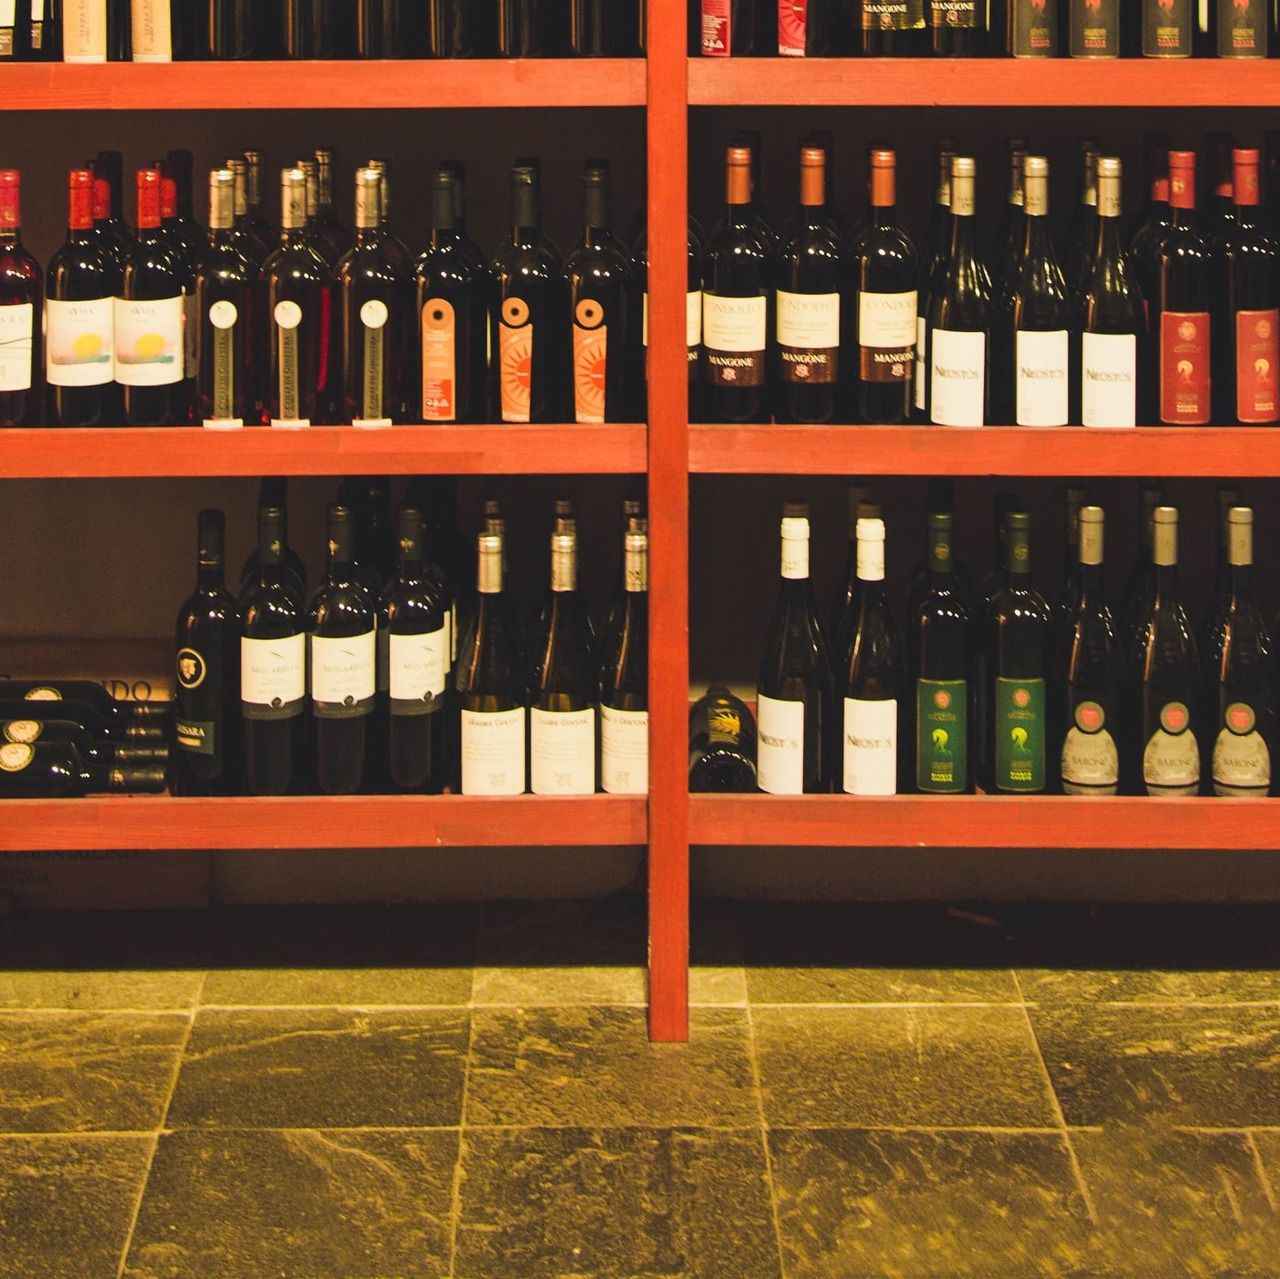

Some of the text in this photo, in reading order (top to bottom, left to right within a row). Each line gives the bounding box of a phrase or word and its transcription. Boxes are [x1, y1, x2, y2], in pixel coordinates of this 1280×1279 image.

[863, 3, 908, 13] MANGONE
[931, 1, 976, 12] MANGONE
[708, 355, 754, 367] MANGONE
[781, 352, 827, 363] MANGONE
